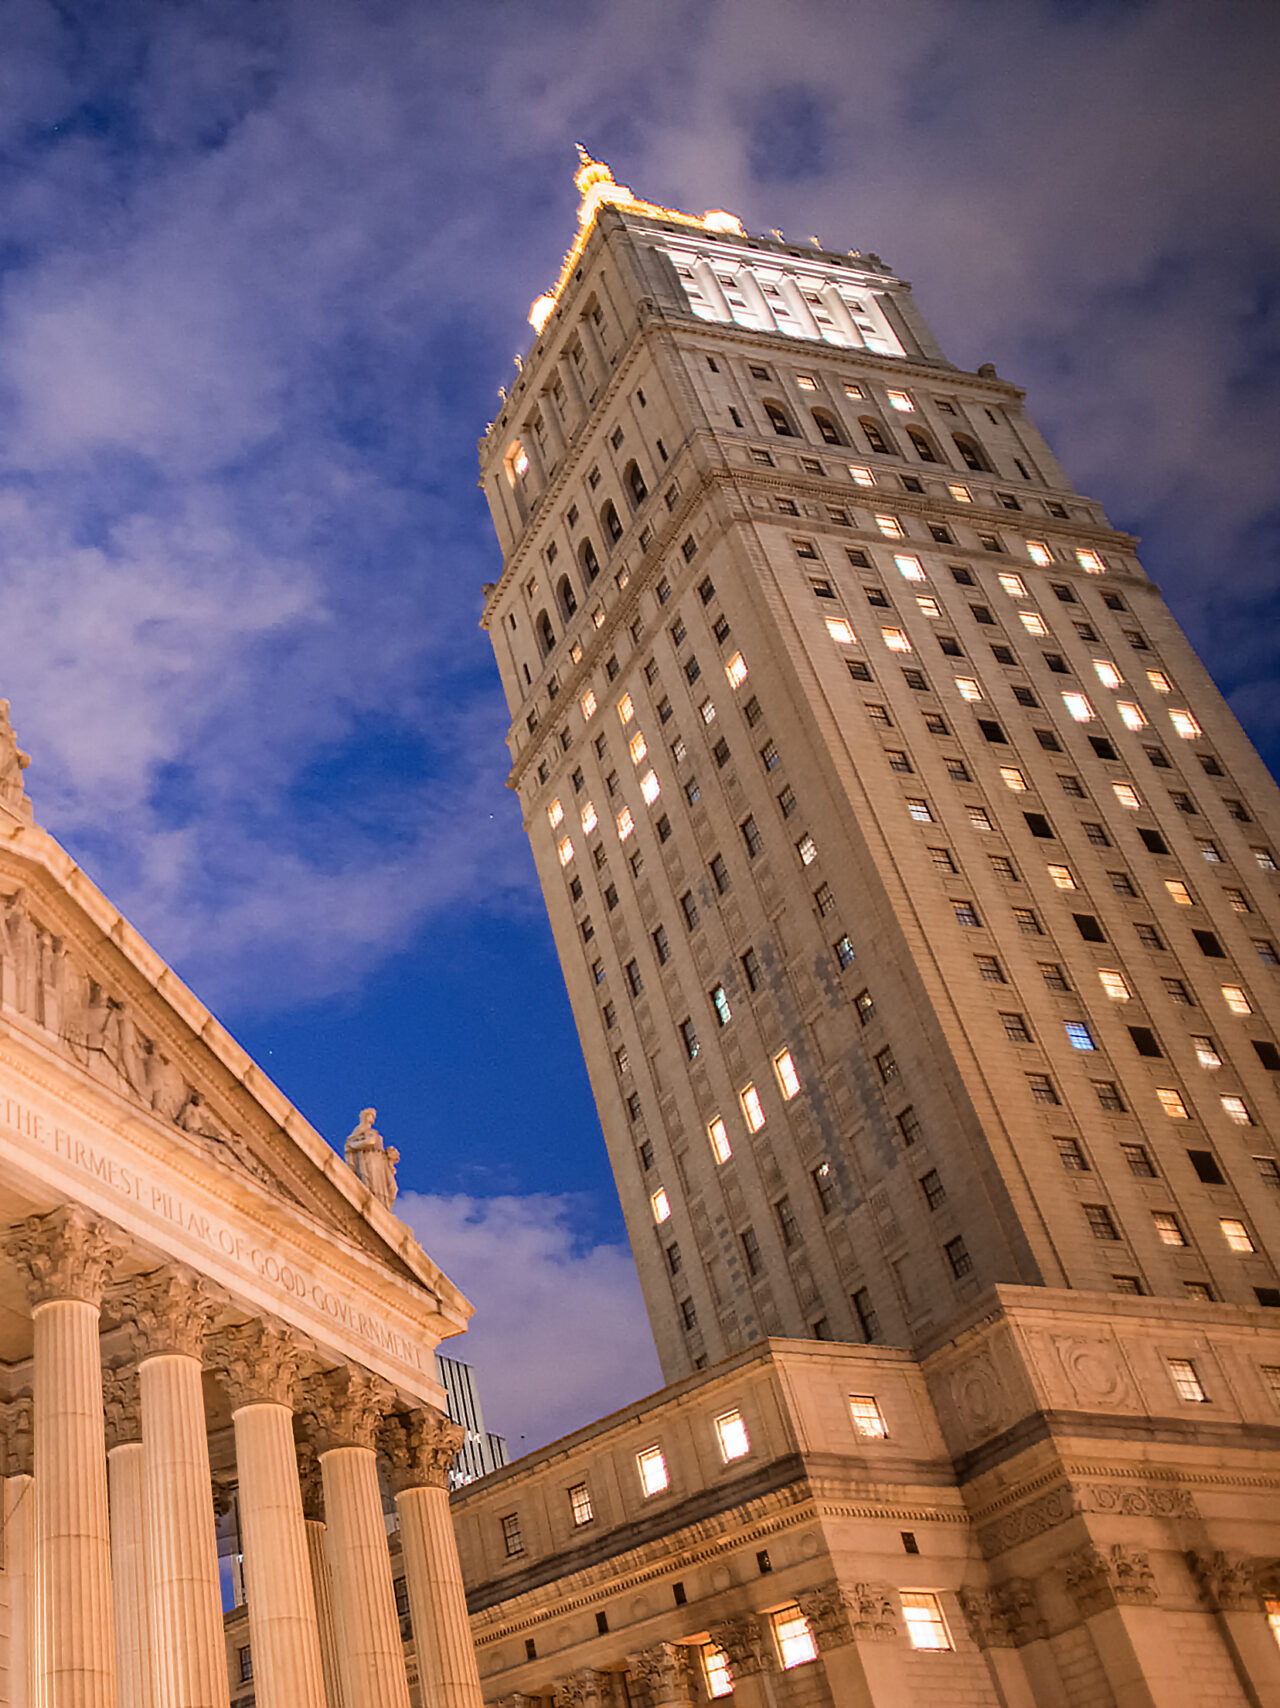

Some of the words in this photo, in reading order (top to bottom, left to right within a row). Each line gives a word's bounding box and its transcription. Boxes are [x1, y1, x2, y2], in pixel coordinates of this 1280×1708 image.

[5, 1099, 46, 1144] THE
[55, 1127, 144, 1200] FIRMEST
[152, 1185, 213, 1238] PILLAR
[219, 1230, 244, 1260] OF
[251, 1248, 306, 1298] GOOD
[312, 1285, 423, 1369] GOVERNMENT
